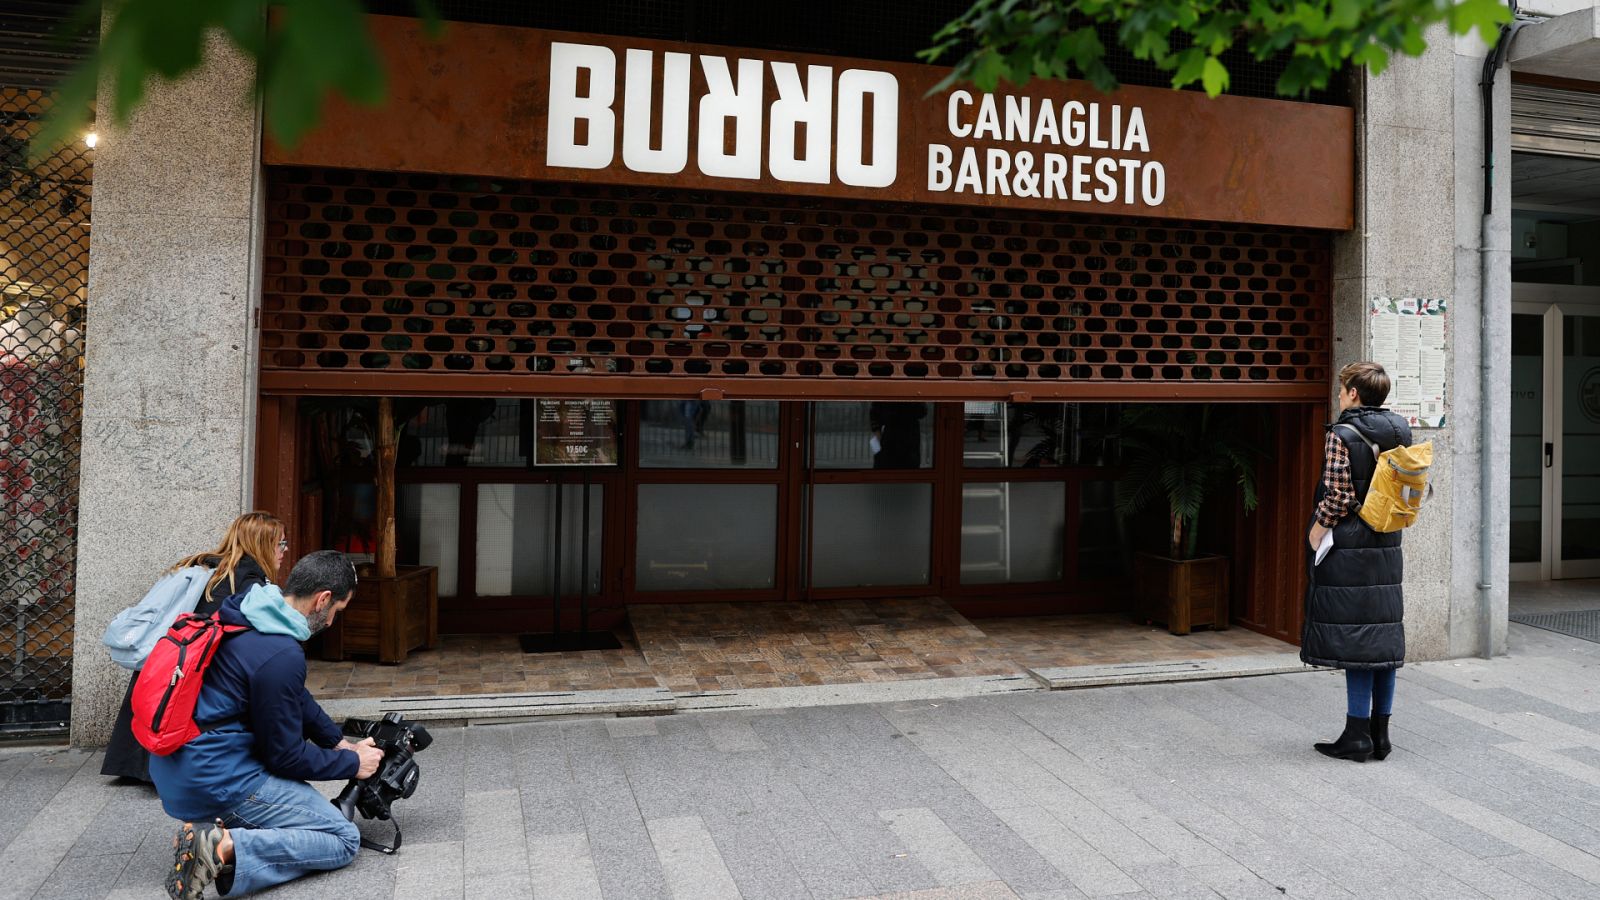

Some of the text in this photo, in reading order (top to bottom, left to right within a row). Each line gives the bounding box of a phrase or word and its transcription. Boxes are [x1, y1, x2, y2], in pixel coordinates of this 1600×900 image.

[546, 42, 899, 188] BURRO
[948, 89, 1150, 153] CANAGLIA
[927, 143, 1166, 206] BAR&RESTO
